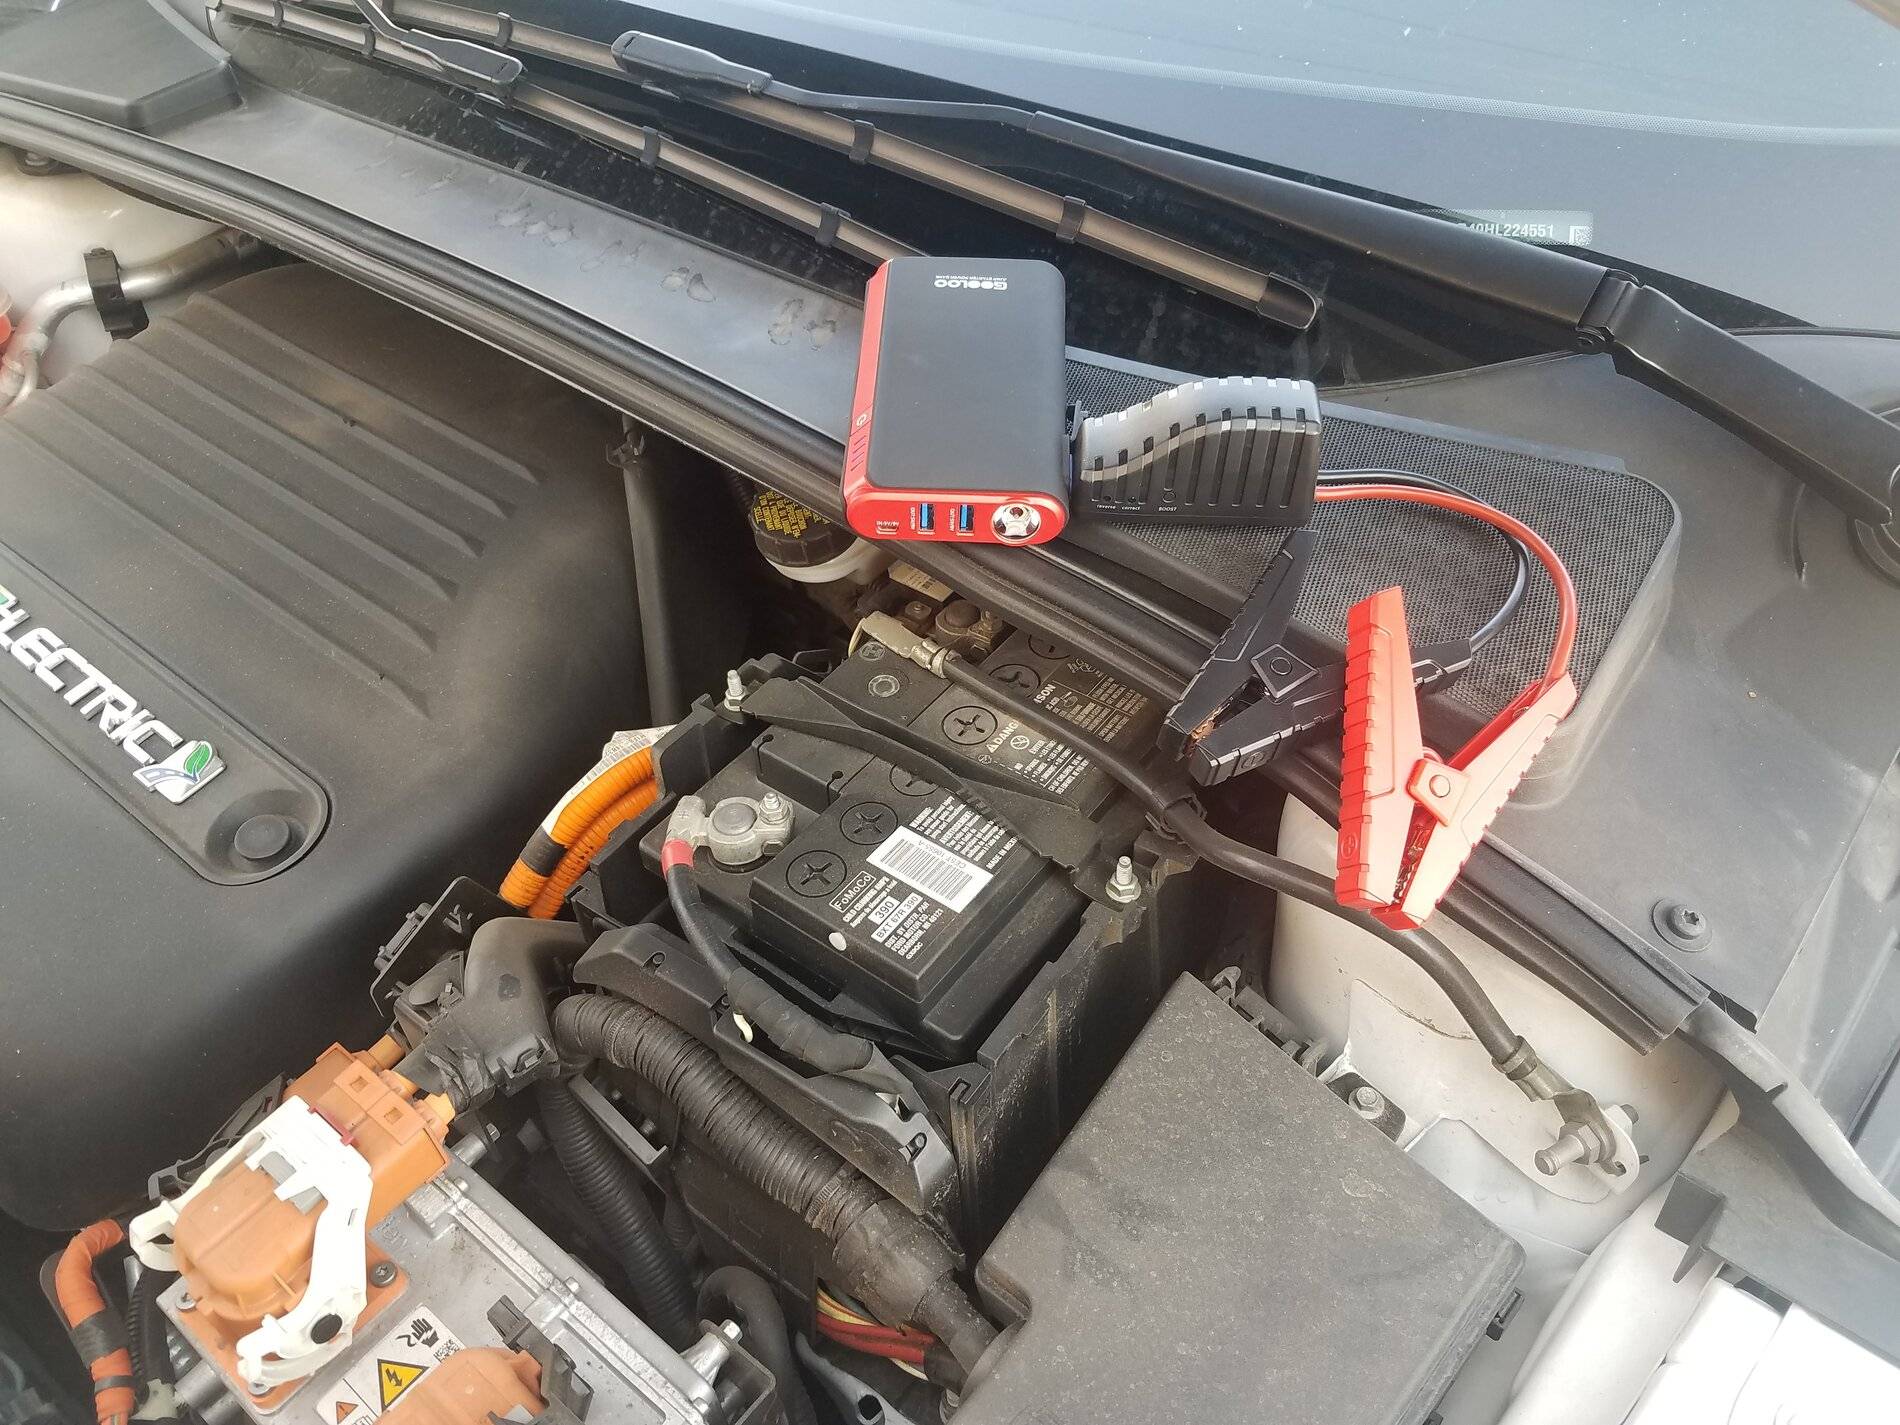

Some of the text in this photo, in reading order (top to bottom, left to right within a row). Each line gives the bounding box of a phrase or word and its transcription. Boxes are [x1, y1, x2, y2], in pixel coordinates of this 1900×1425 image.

[934, 279, 1007, 290] GOOLOO
[0, 590, 183, 768] LECTRIC
[1033, 683, 1057, 704] ISON
[996, 721, 1019, 748] DANG
[835, 874, 871, 909] FoMoCo
[875, 901, 895, 918] 390
[876, 896, 919, 938] BXT 67R 390
[903, 921, 922, 938] MOTOR
